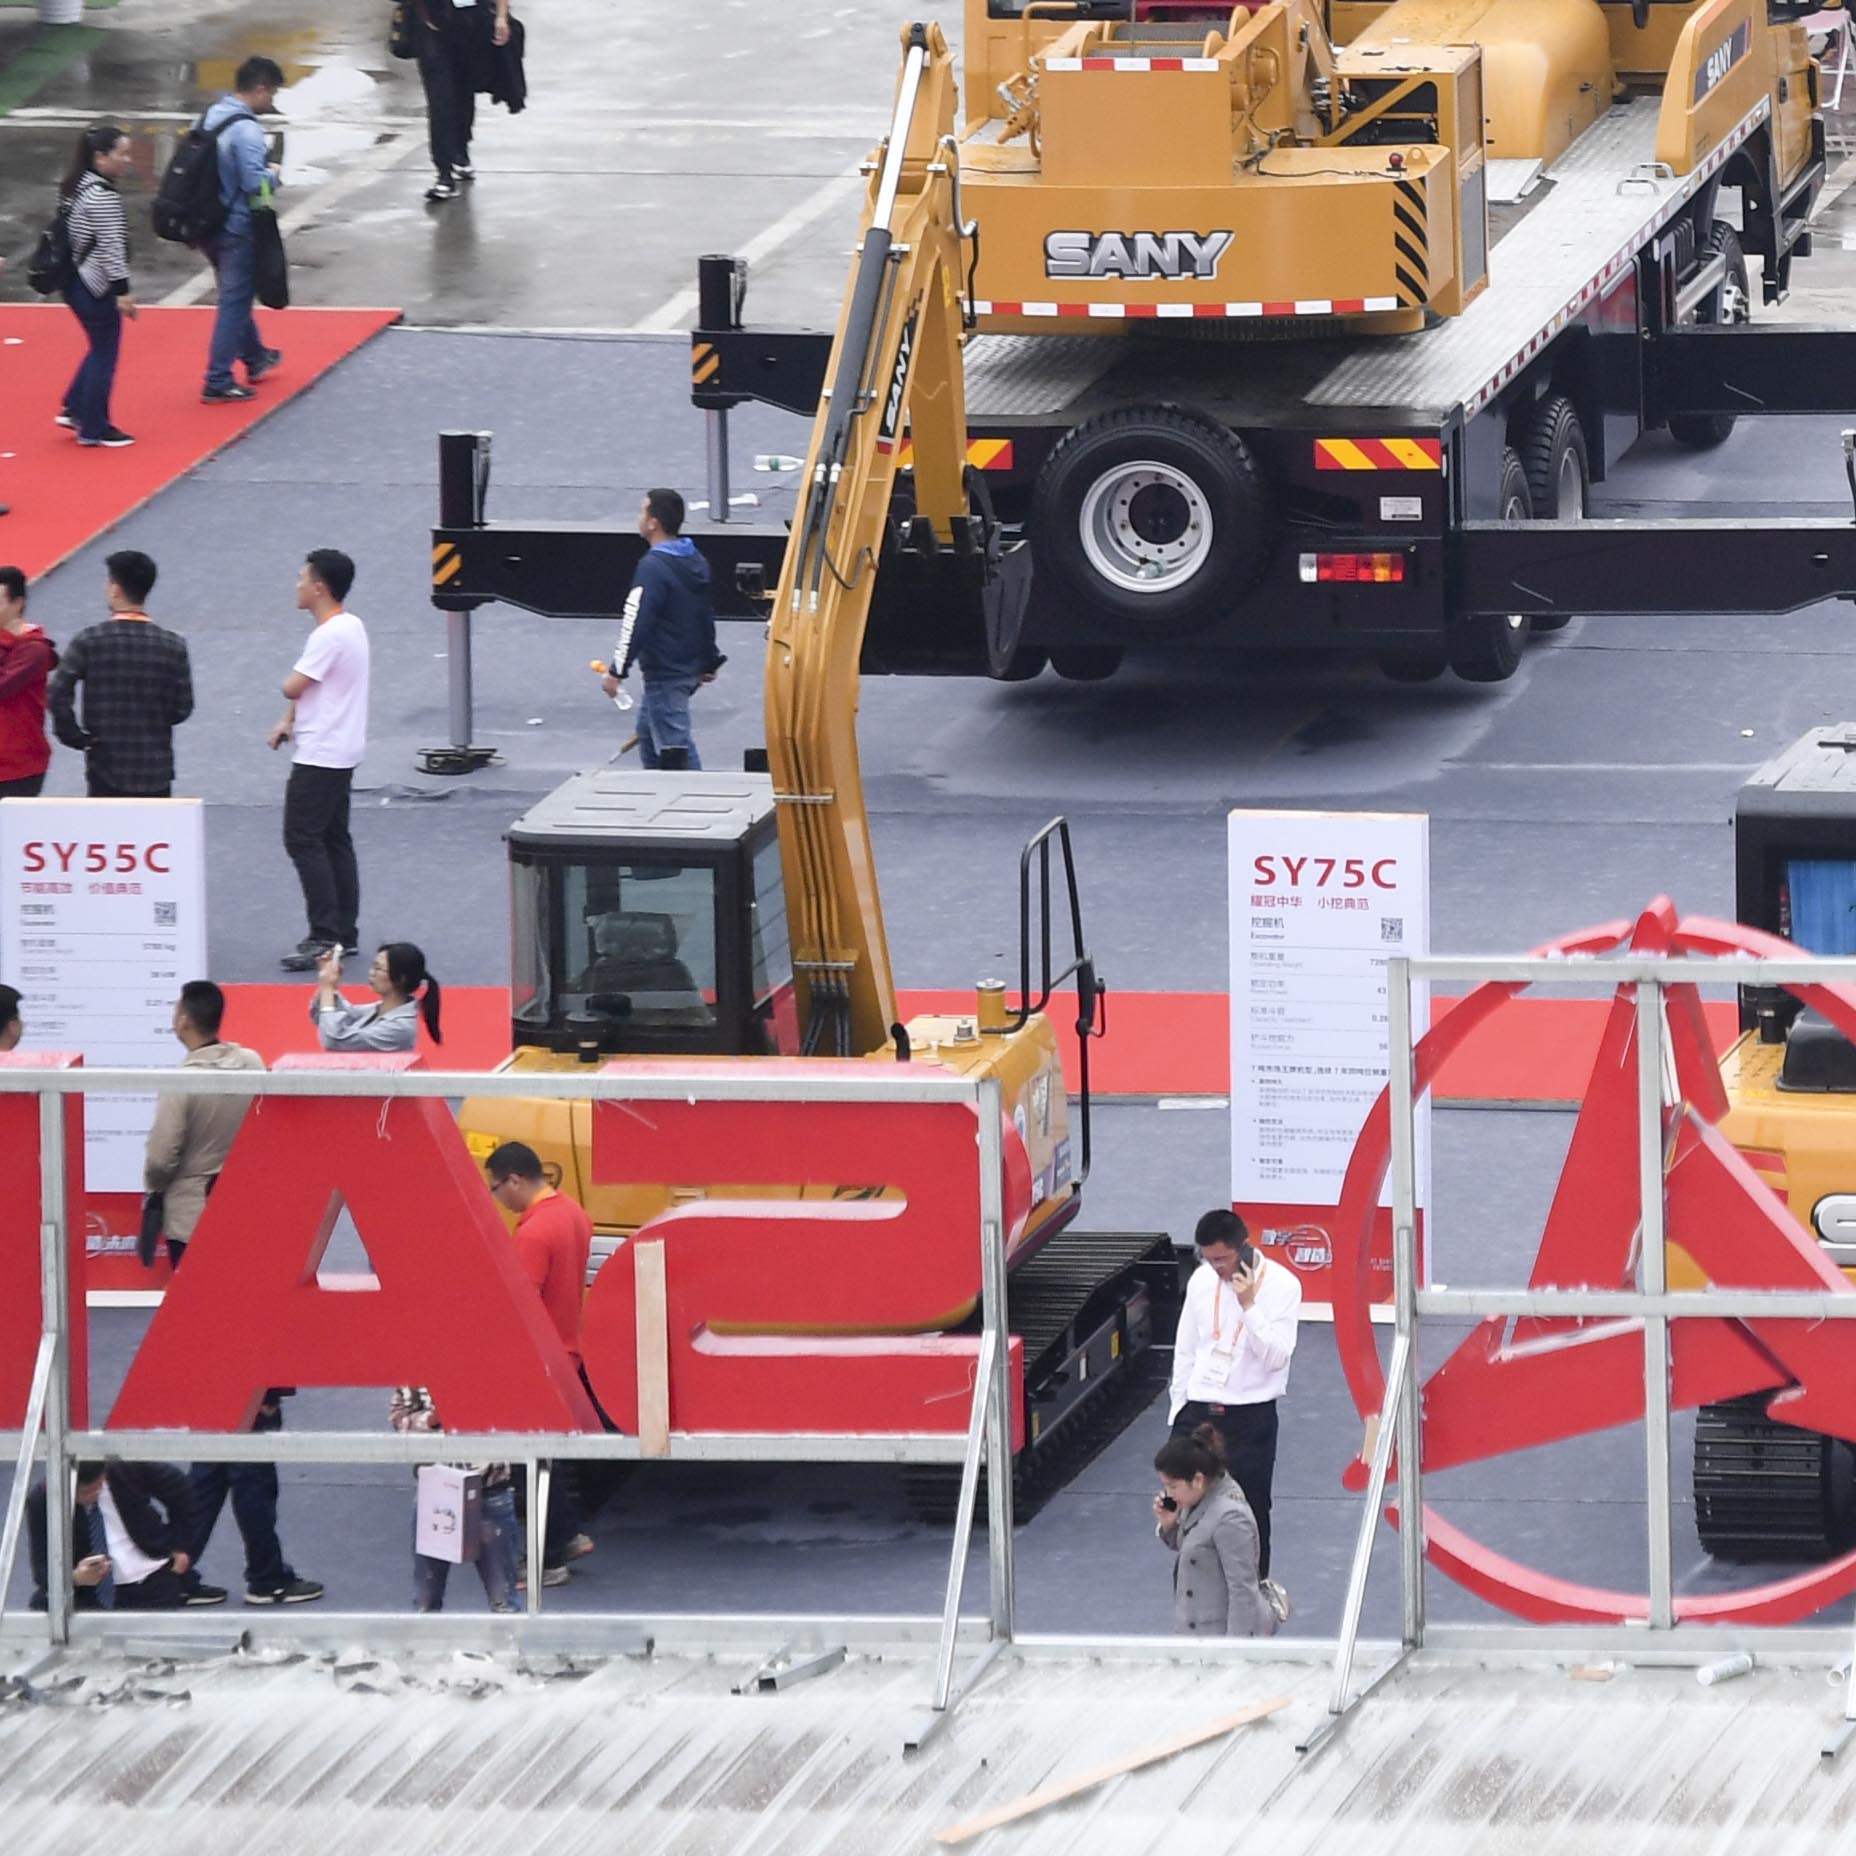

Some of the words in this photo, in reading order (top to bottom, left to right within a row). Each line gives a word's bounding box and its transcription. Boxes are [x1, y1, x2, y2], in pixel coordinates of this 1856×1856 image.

[1706, 39, 1733, 88] SANY
[1044, 231, 1234, 280] SANY
[884, 327, 912, 434] SANY
[22, 842, 170, 873] SY55C
[1253, 855, 1397, 889] SY75C
[1250, 917, 1285, 929] 挖掘机
